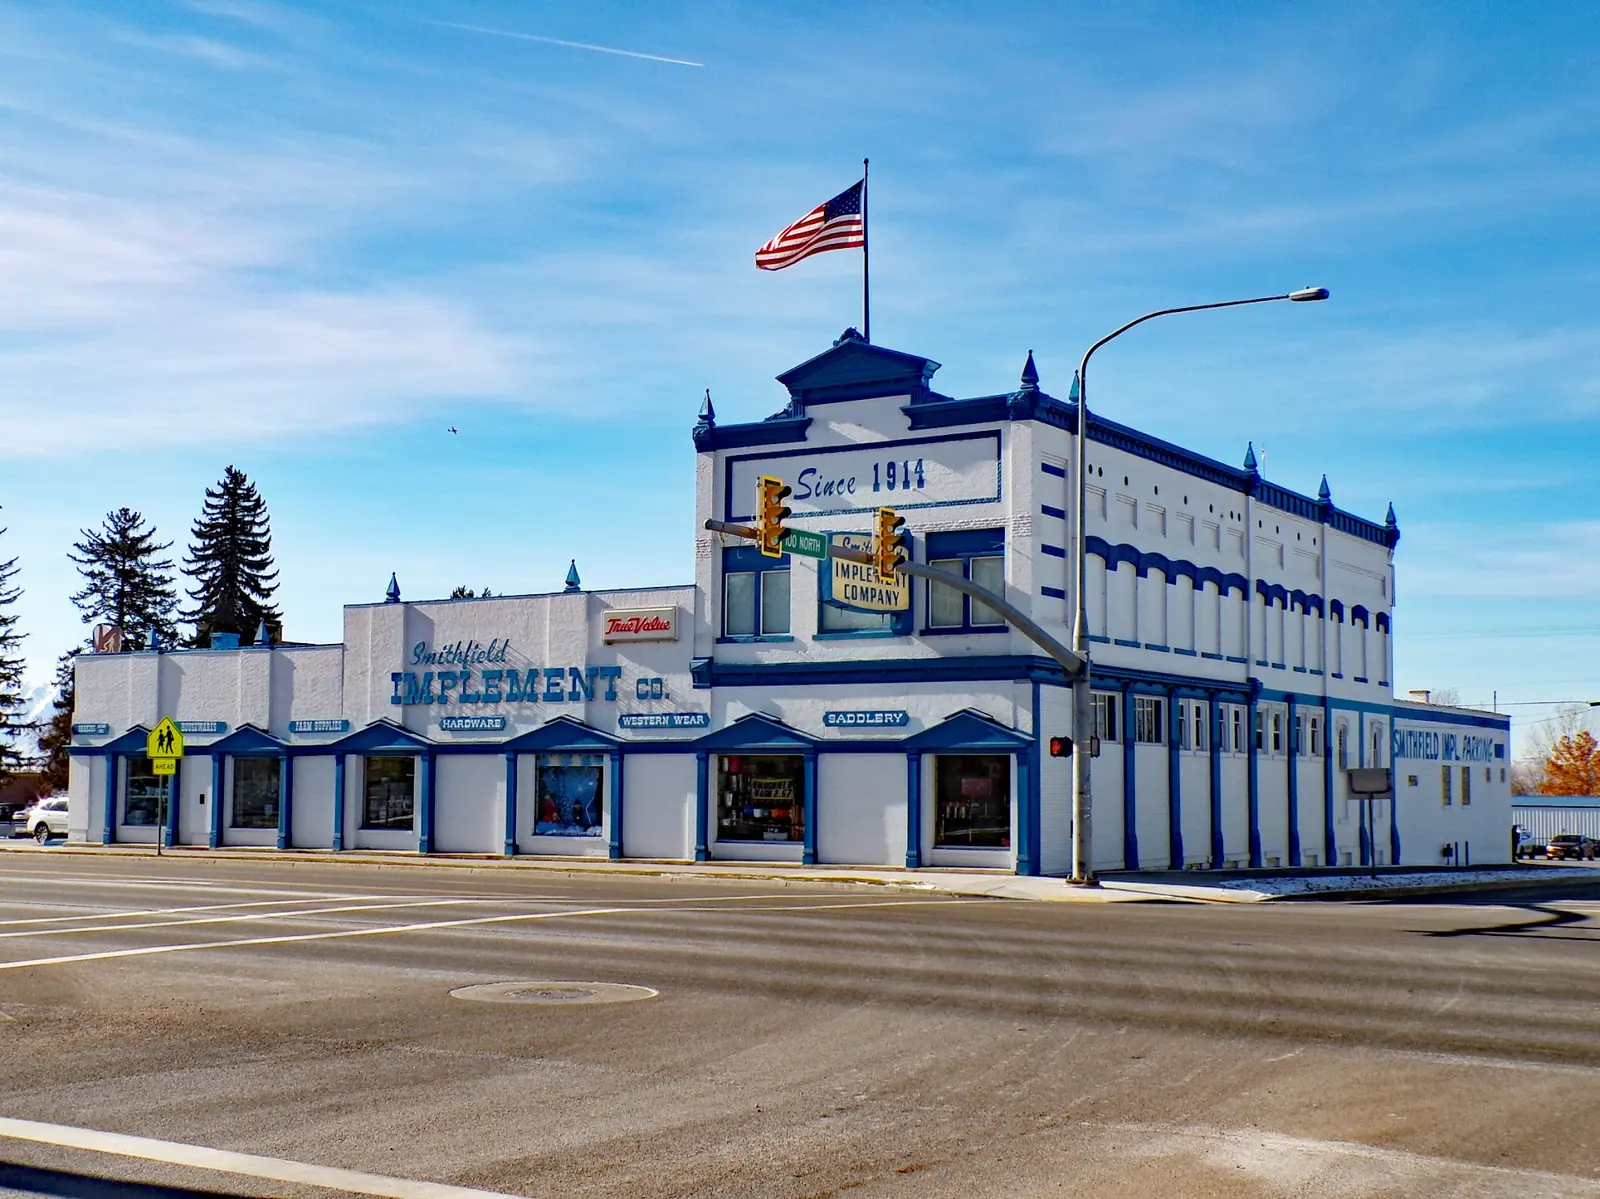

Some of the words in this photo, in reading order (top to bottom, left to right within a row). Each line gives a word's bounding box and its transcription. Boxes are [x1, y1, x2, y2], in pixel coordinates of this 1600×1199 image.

[793, 467, 857, 501] Since
[872, 458, 926, 493] 1914
[799, 536, 821, 552] NORTH
[844, 584, 900, 606] COMPANY
[411, 639, 509, 668] Smithfield
[390, 666, 622, 705] IMPLEMENT
[636, 677, 670, 700] CO.
[295, 721, 312, 731] FARM
[314, 720, 342, 731] SUPPLIES
[442, 718, 502, 729] HARDWARE
[622, 715, 670, 726] WESTERN
[673, 714, 706, 725] WEAR
[827, 712, 904, 725] SADDLERY
[1393, 729, 1439, 760] SMITHFIELD
[1463, 735, 1493, 762] PARKING
